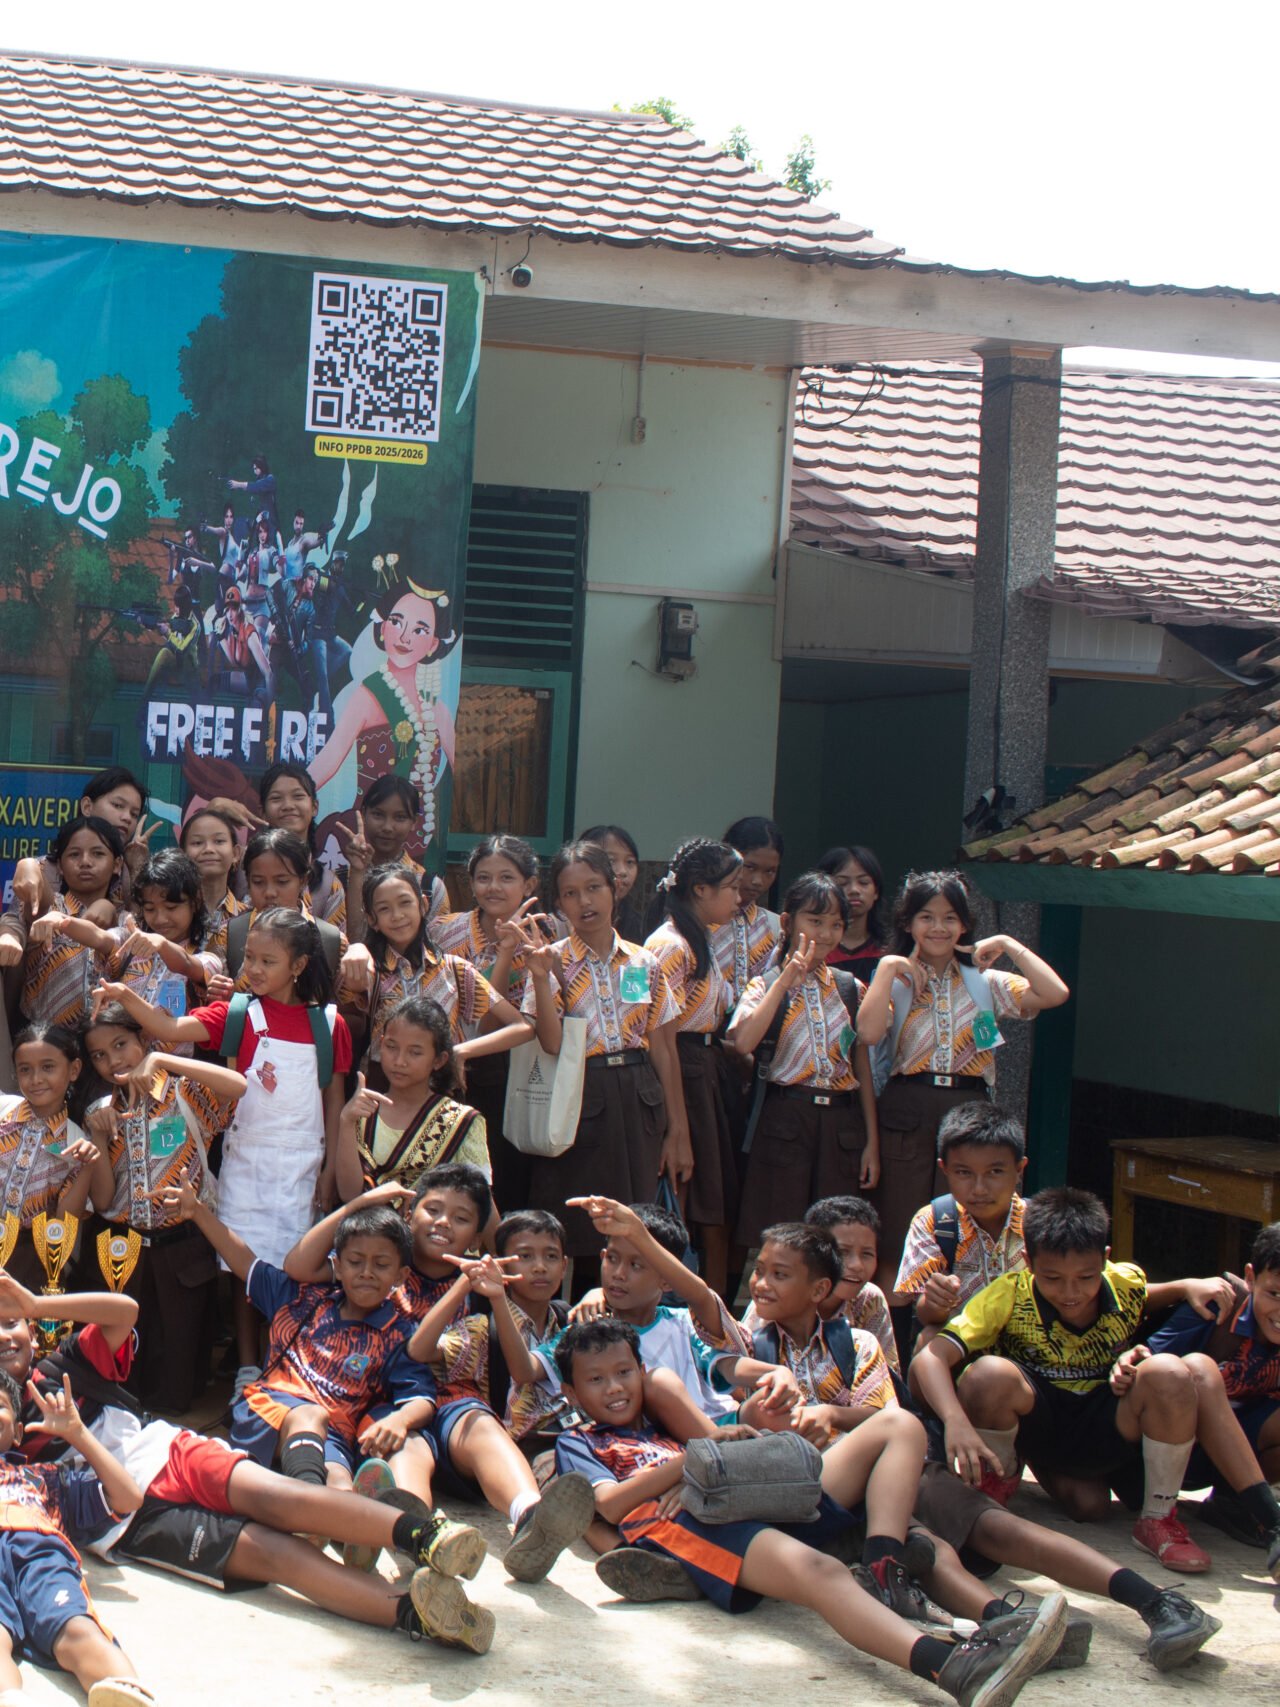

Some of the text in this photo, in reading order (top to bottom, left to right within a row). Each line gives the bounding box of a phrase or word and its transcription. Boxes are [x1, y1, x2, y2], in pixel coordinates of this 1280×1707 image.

[318, 441, 424, 460] INFO PPDB 2025/2026
[146, 701, 235, 760] FREE
[161, 1133, 175, 1148] 12
